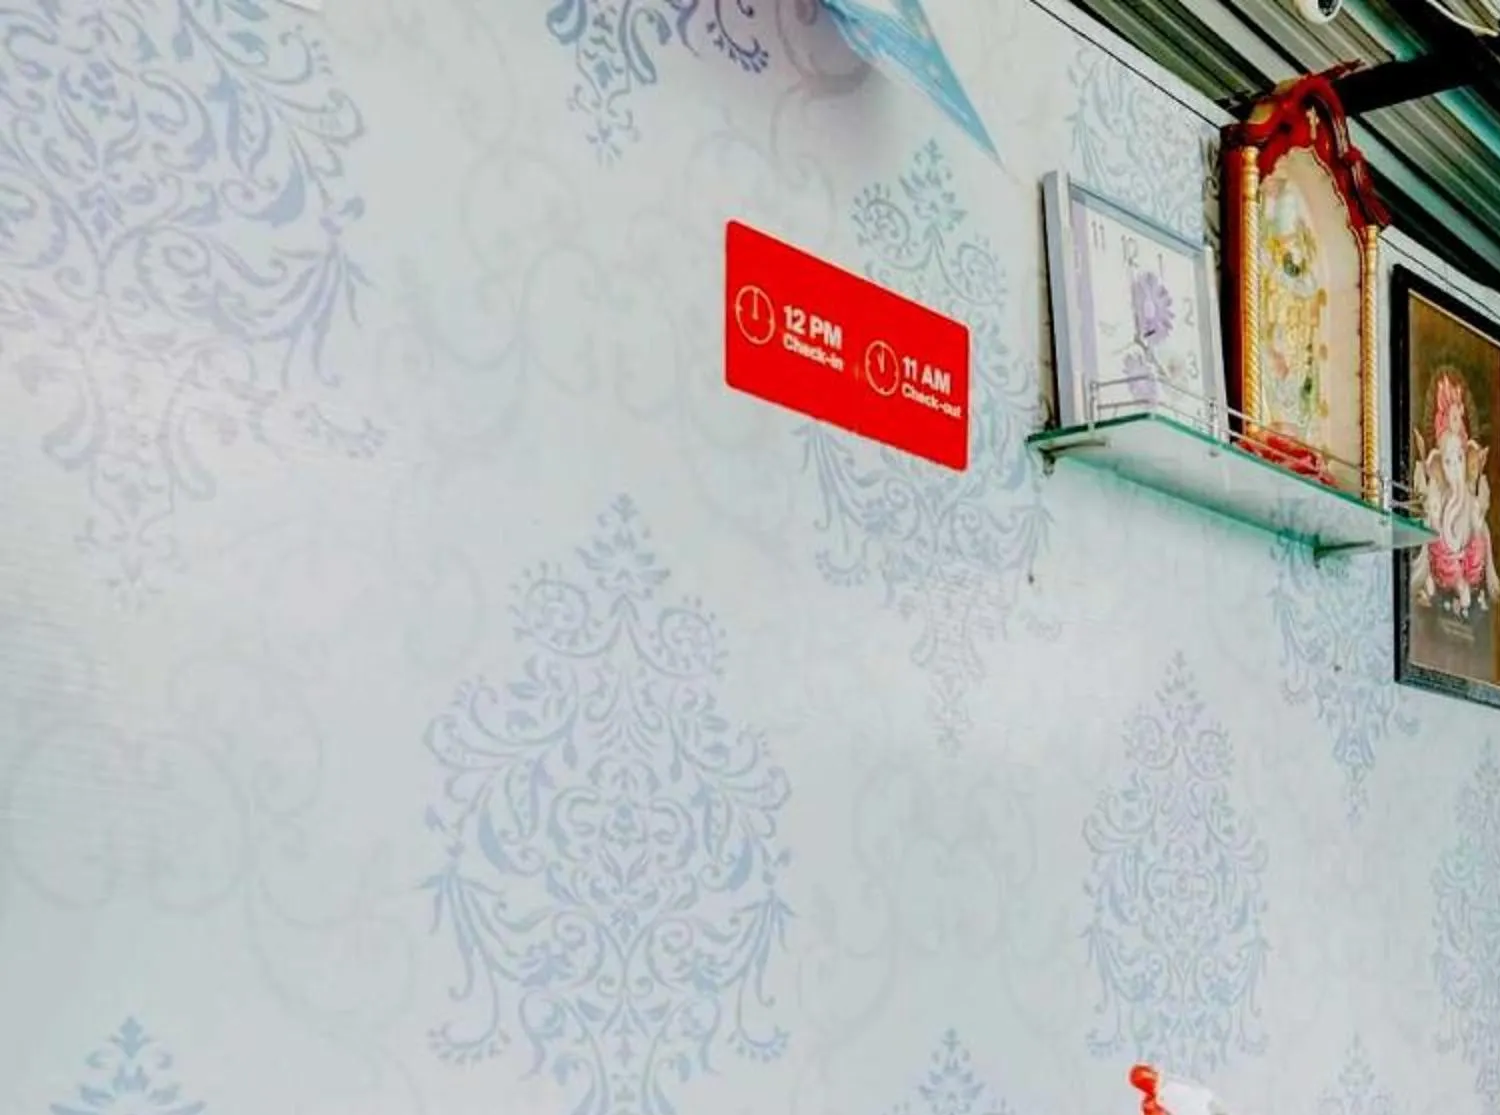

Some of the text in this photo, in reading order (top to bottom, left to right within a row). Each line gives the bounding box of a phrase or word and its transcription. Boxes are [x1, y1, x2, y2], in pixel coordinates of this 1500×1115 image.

[783, 304, 843, 350] 12 PM
[783, 333, 845, 372] Check-in
[902, 355, 951, 395] 11 AM
[902, 383, 962, 419] Check-out
